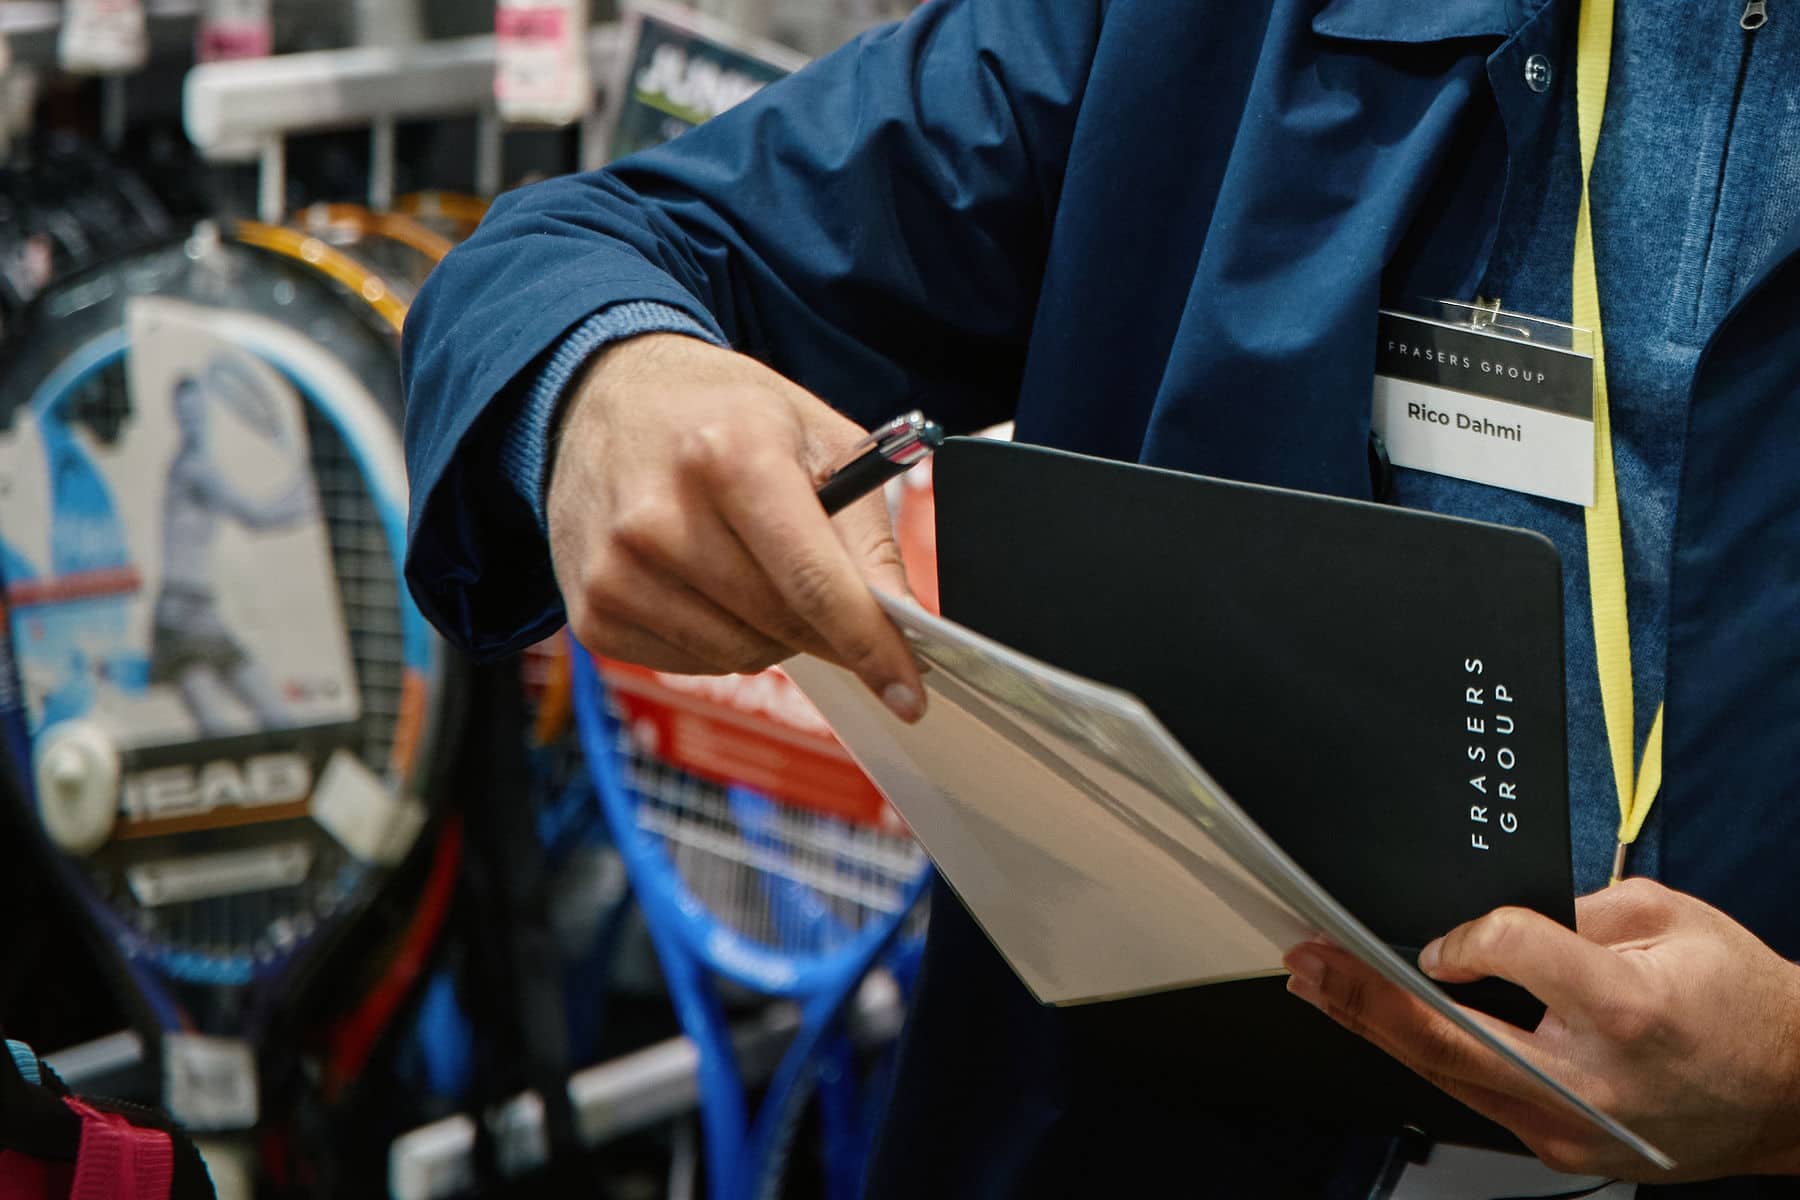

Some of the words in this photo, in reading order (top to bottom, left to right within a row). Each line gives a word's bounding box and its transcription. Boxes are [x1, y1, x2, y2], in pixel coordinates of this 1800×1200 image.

[1387, 340, 1471, 369] FRASERS
[1480, 361, 1546, 384] GROUP
[1407, 401, 1450, 426] Rico
[1455, 412, 1523, 443] Dahmi
[1464, 657, 1490, 850] FRASERS
[1495, 683, 1519, 833] GROUP
